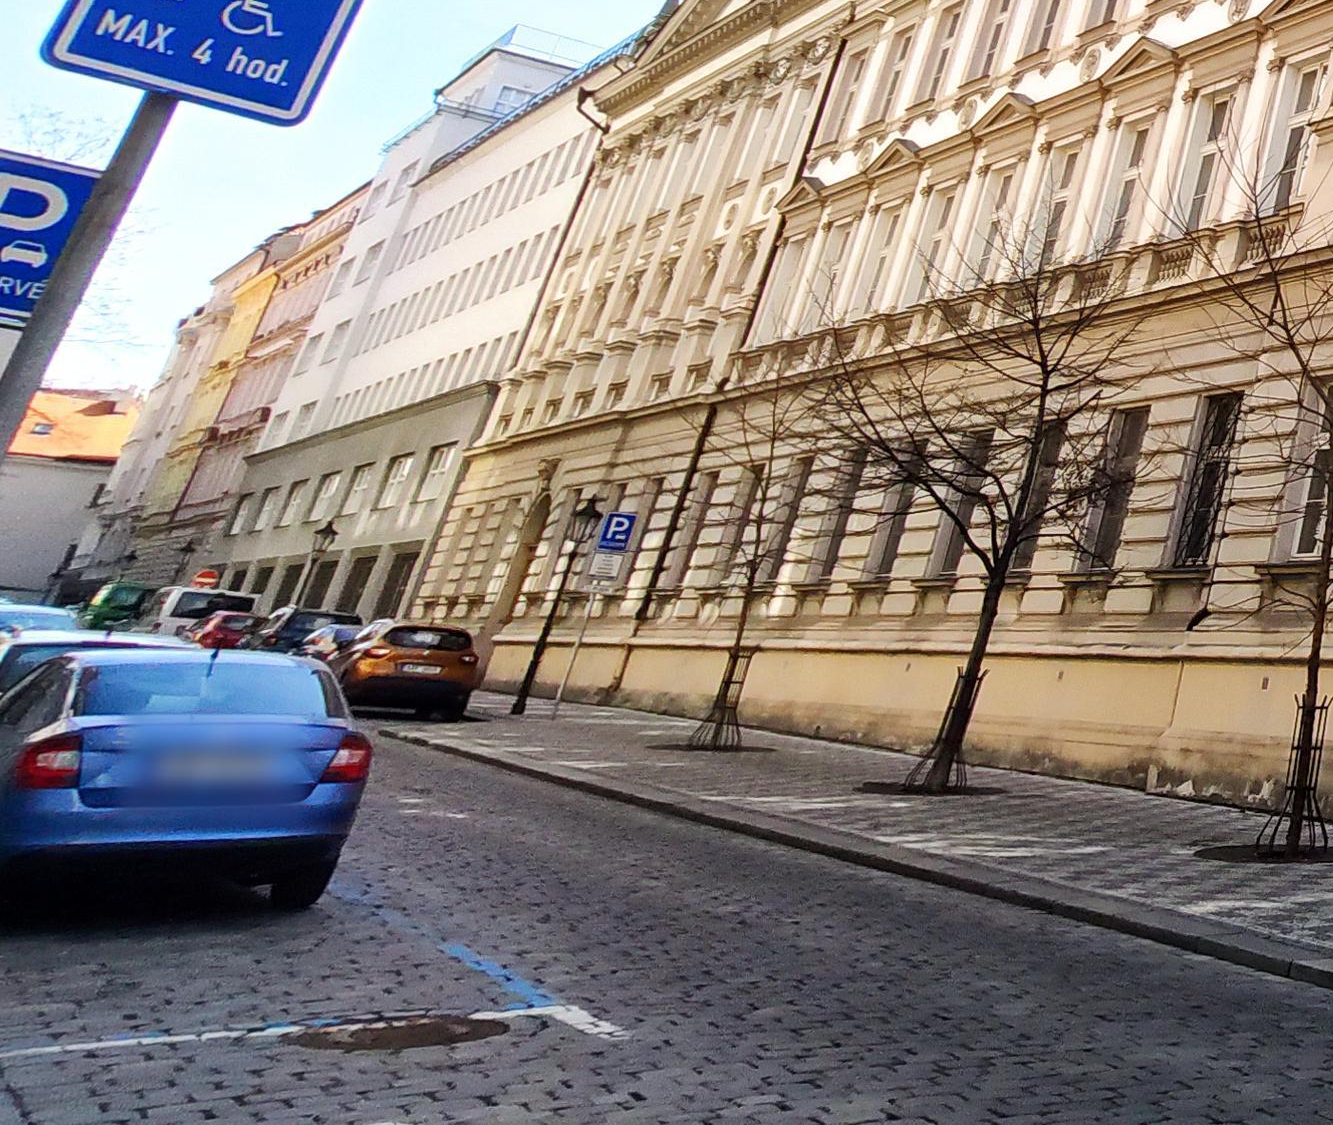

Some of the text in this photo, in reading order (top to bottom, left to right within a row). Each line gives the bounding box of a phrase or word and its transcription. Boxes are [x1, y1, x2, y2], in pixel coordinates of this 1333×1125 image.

[95, 9, 289, 86] MAX. 4 hod.
[606, 516, 630, 539] P
